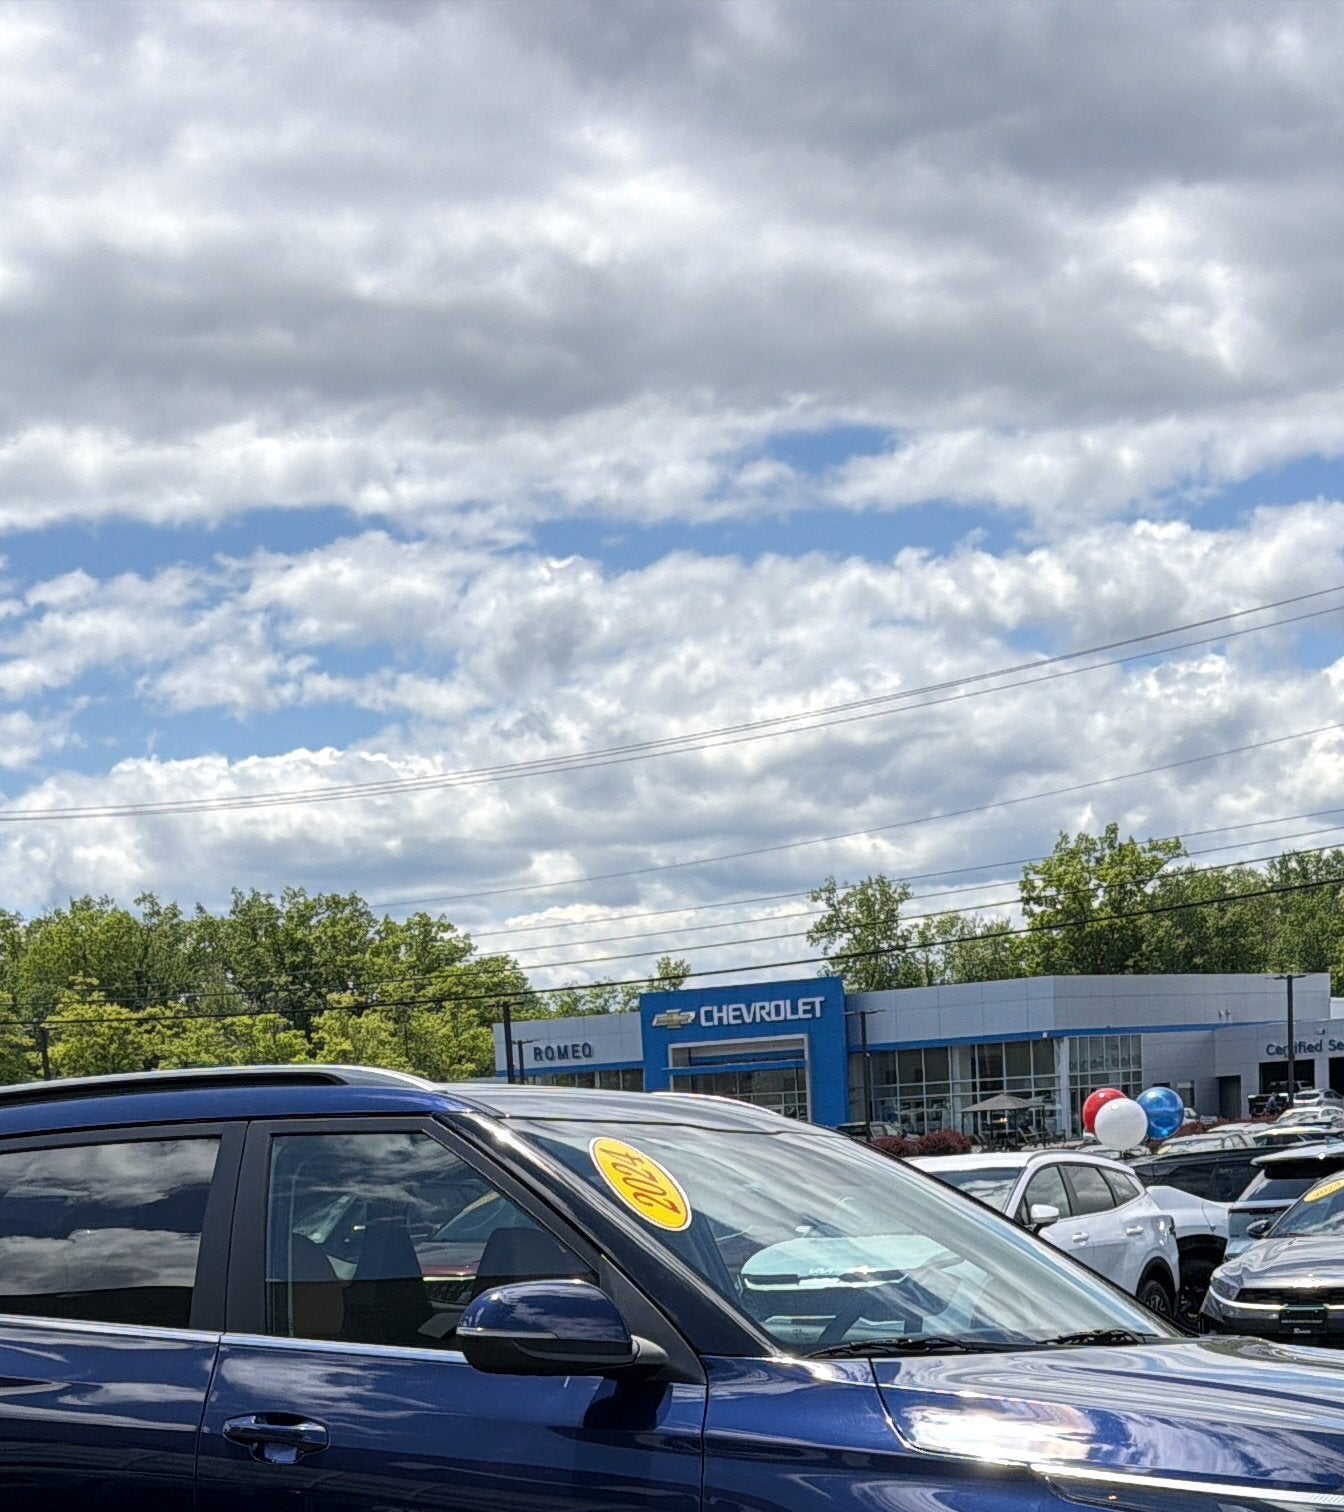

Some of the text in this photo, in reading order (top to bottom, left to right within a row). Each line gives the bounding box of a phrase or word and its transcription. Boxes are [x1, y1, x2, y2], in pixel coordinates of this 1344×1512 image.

[700, 997, 825, 1027] CHEVROLET
[533, 1042, 593, 1062] ROMEO
[1265, 1040, 1323, 1056] Cerified
[598, 1147, 682, 1215] 2024
